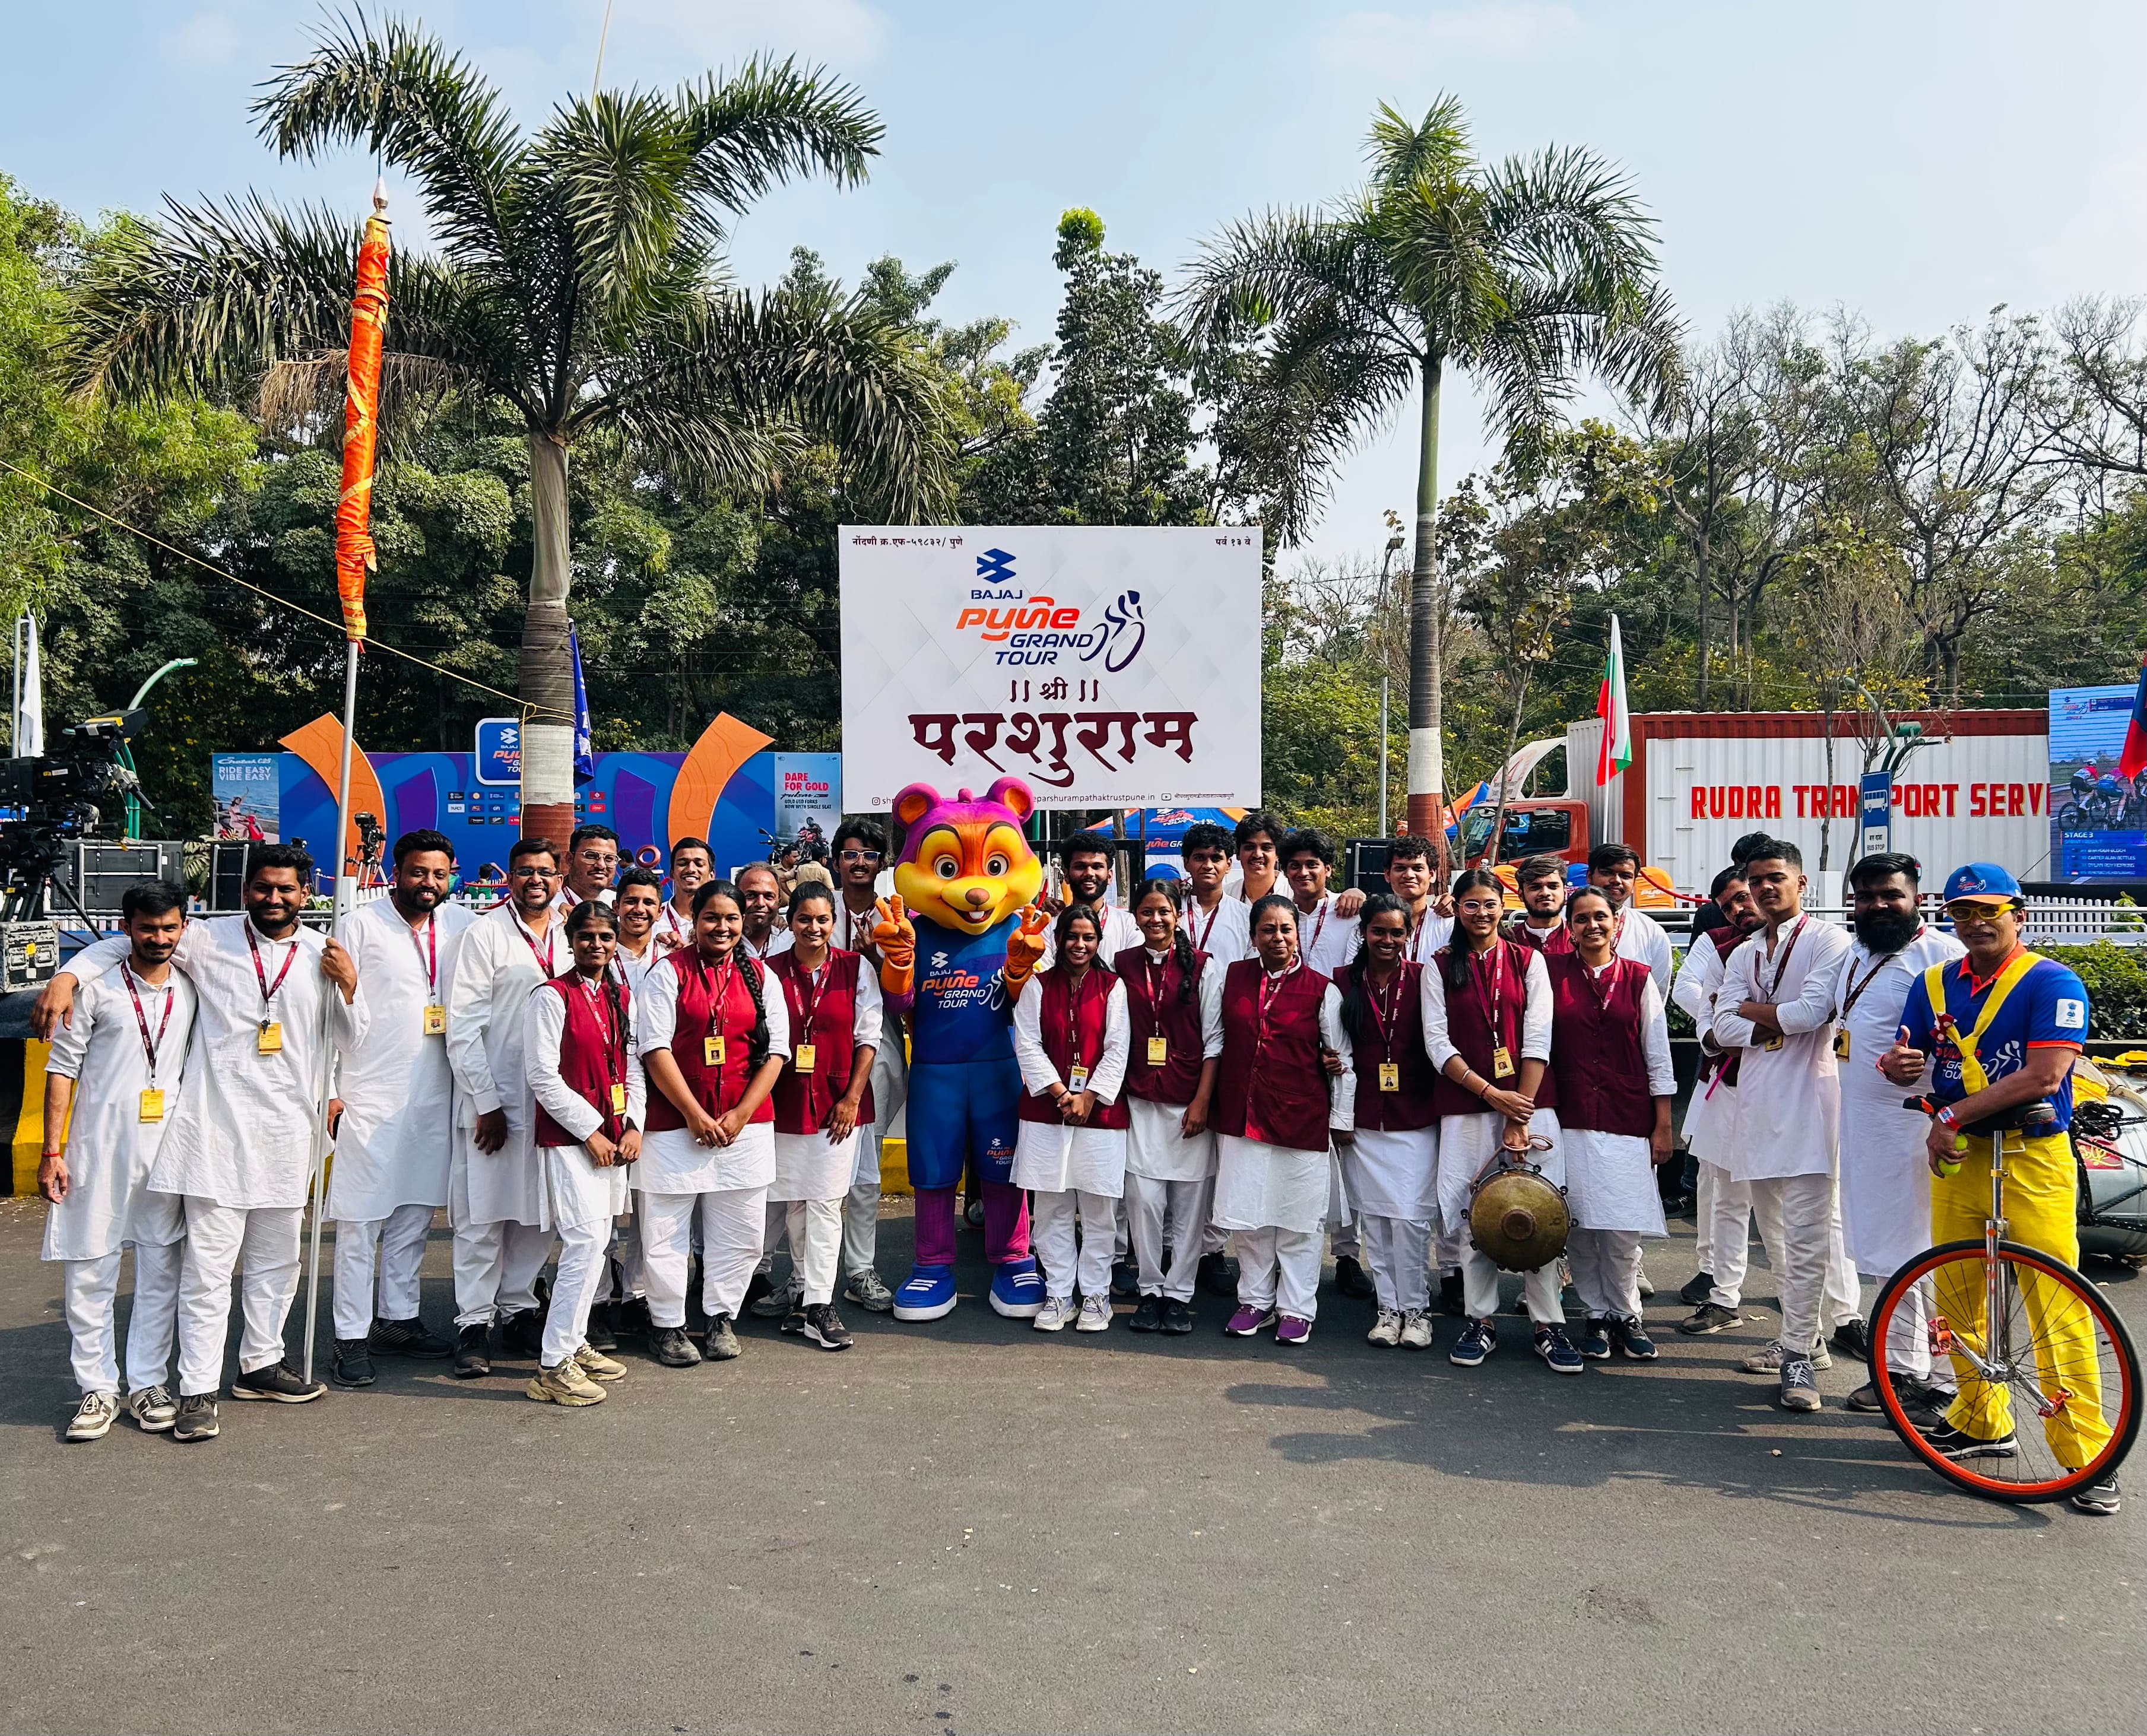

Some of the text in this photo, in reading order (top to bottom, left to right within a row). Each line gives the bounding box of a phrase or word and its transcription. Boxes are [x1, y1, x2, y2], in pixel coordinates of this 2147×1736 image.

[949, 535, 963, 548] पुणे
[971, 590, 1023, 599] BAJAJ
[1010, 634, 1093, 648] GRAND
[995, 651, 1058, 665] TOUR
[1039, 677, 1068, 700] श्री
[908, 712, 1199, 788] परशुराम
[785, 773, 808, 781] DARE
[785, 782, 829, 791] FOR GOLD
[1033, 794, 1155, 802] eparshurampathaktrustpune.in
[1692, 786, 1781, 819] RUDRA
[1792, 784, 1959, 818] TRANPORT
[944, 989, 986, 998] GRAND
[938, 999, 969, 1008] TOUR
